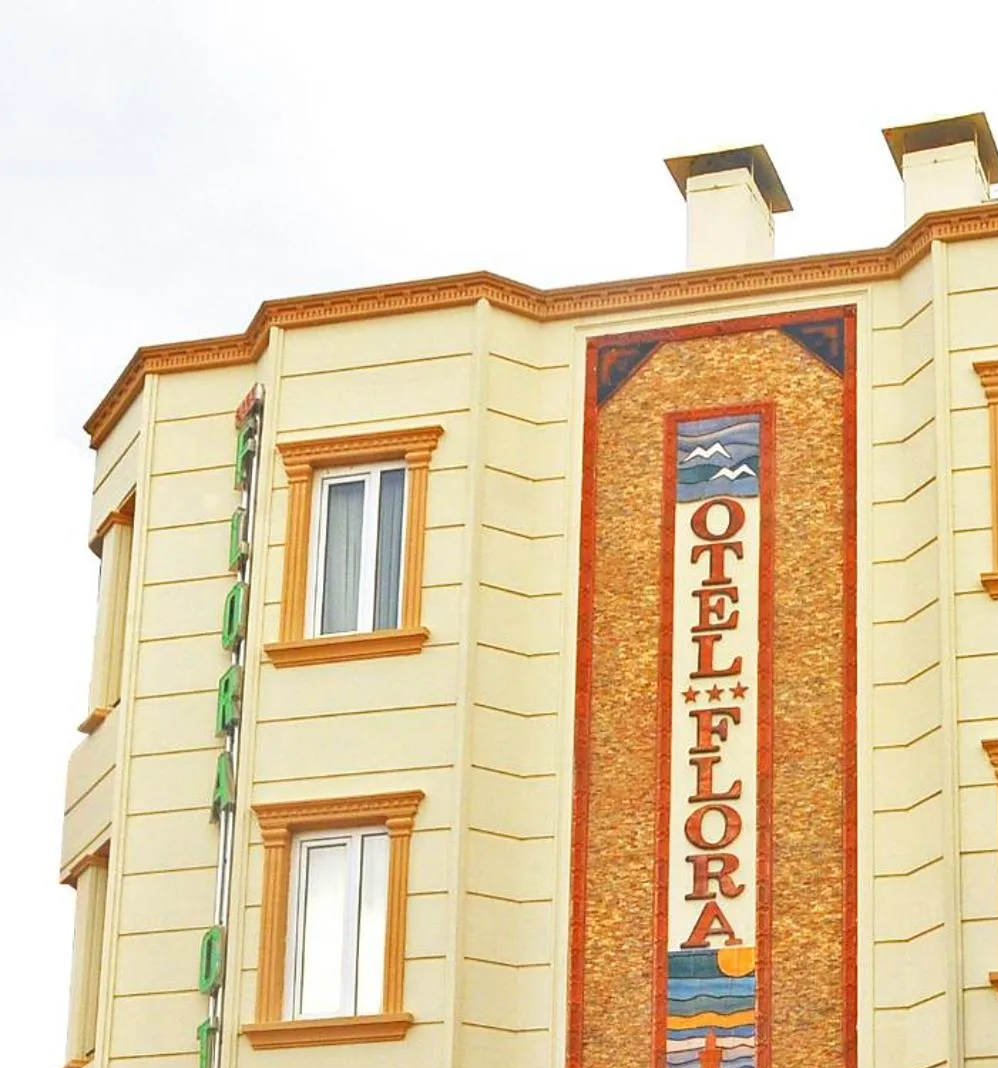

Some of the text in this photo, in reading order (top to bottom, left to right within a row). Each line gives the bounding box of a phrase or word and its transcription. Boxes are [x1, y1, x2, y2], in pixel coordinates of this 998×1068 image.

[213, 423, 256, 820] FLORA
[680, 500, 745, 949] OTEL FLORA
